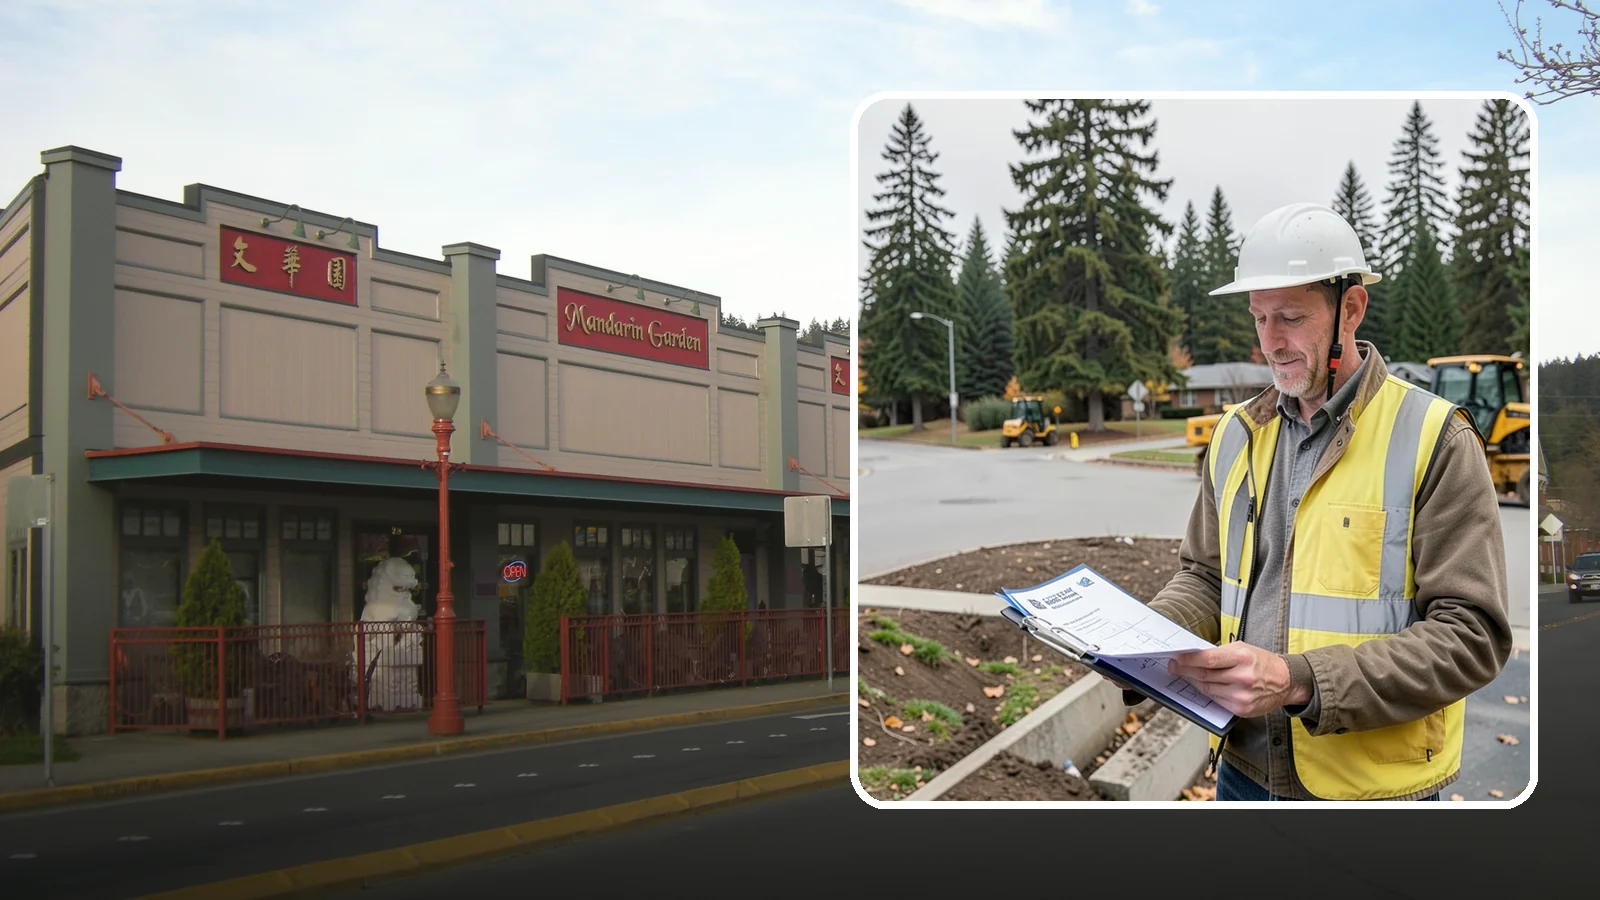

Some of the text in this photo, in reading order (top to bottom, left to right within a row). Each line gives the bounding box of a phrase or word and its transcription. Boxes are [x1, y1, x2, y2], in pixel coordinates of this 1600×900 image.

[231, 235, 346, 291] 文華園
[564, 302, 701, 352] Mandarin Garden
[503, 565, 527, 578] OPEN
